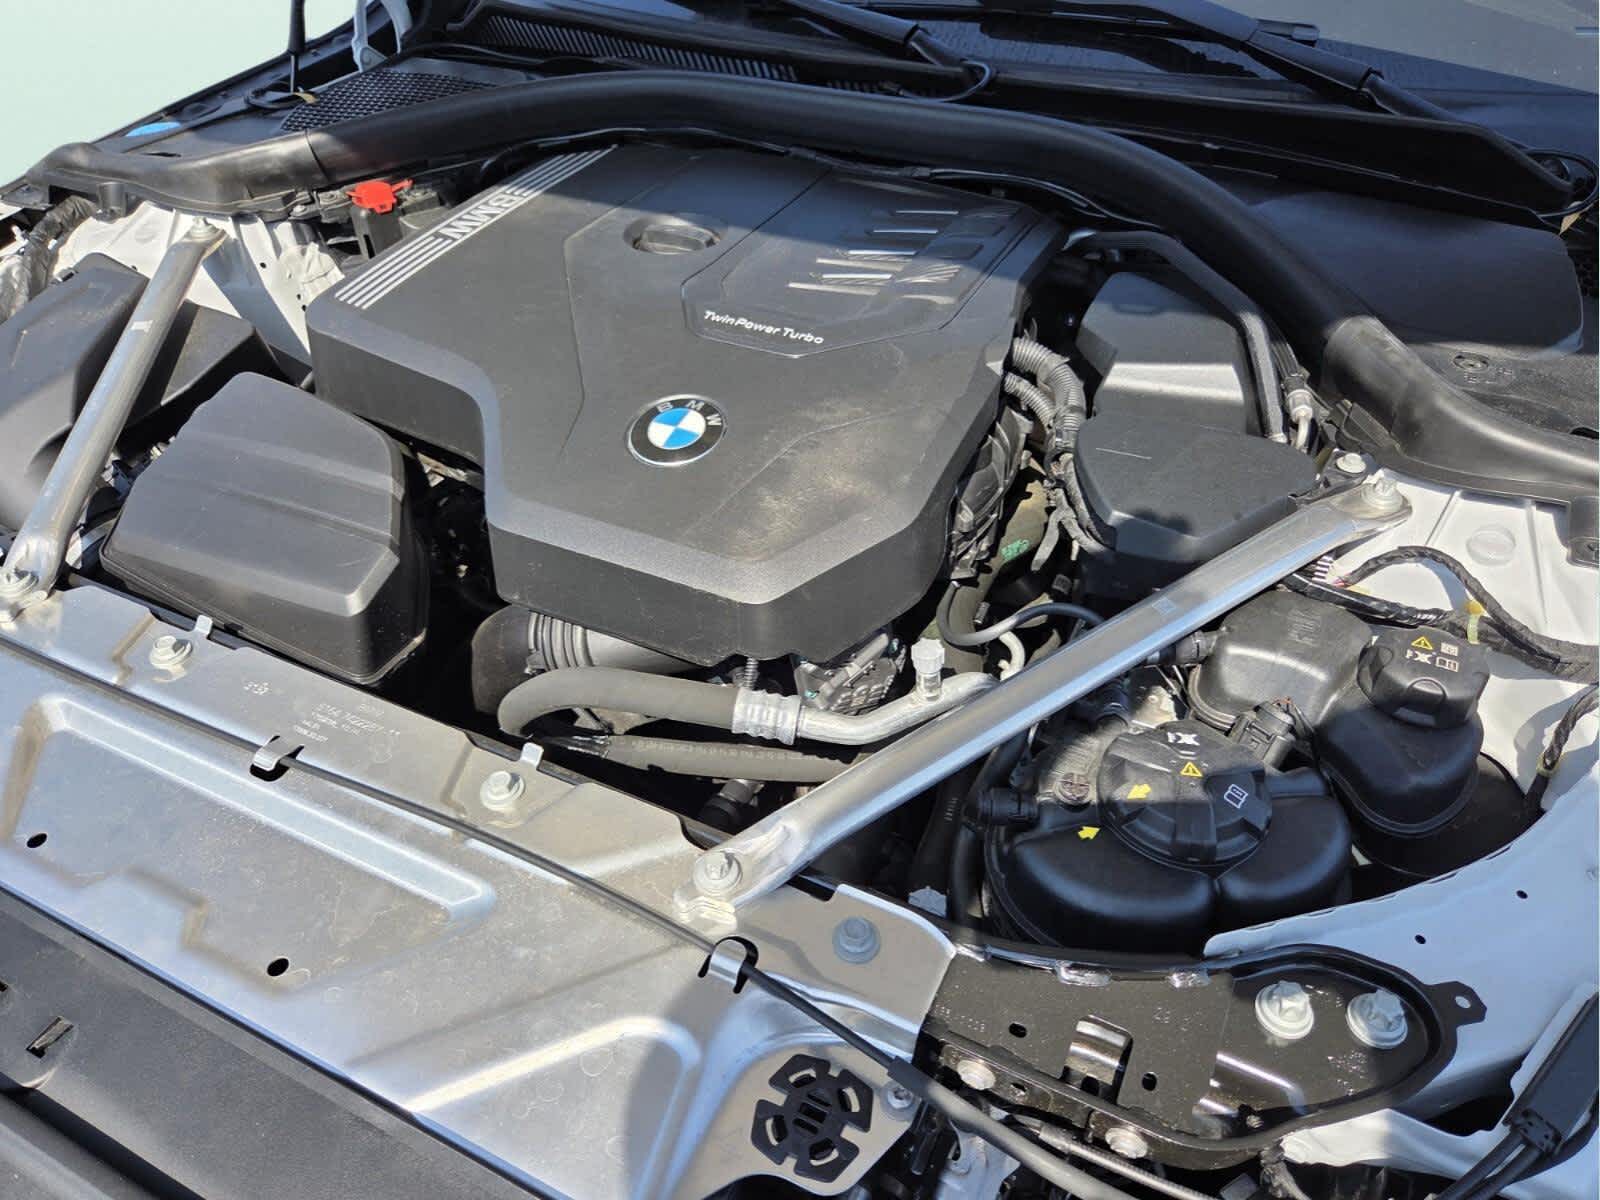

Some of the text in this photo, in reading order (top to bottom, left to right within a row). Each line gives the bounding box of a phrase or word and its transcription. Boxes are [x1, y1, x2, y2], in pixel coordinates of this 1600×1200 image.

[438, 193, 526, 240] BMW
[782, 326, 825, 345] Turbo
[656, 399, 722, 426] BMW
